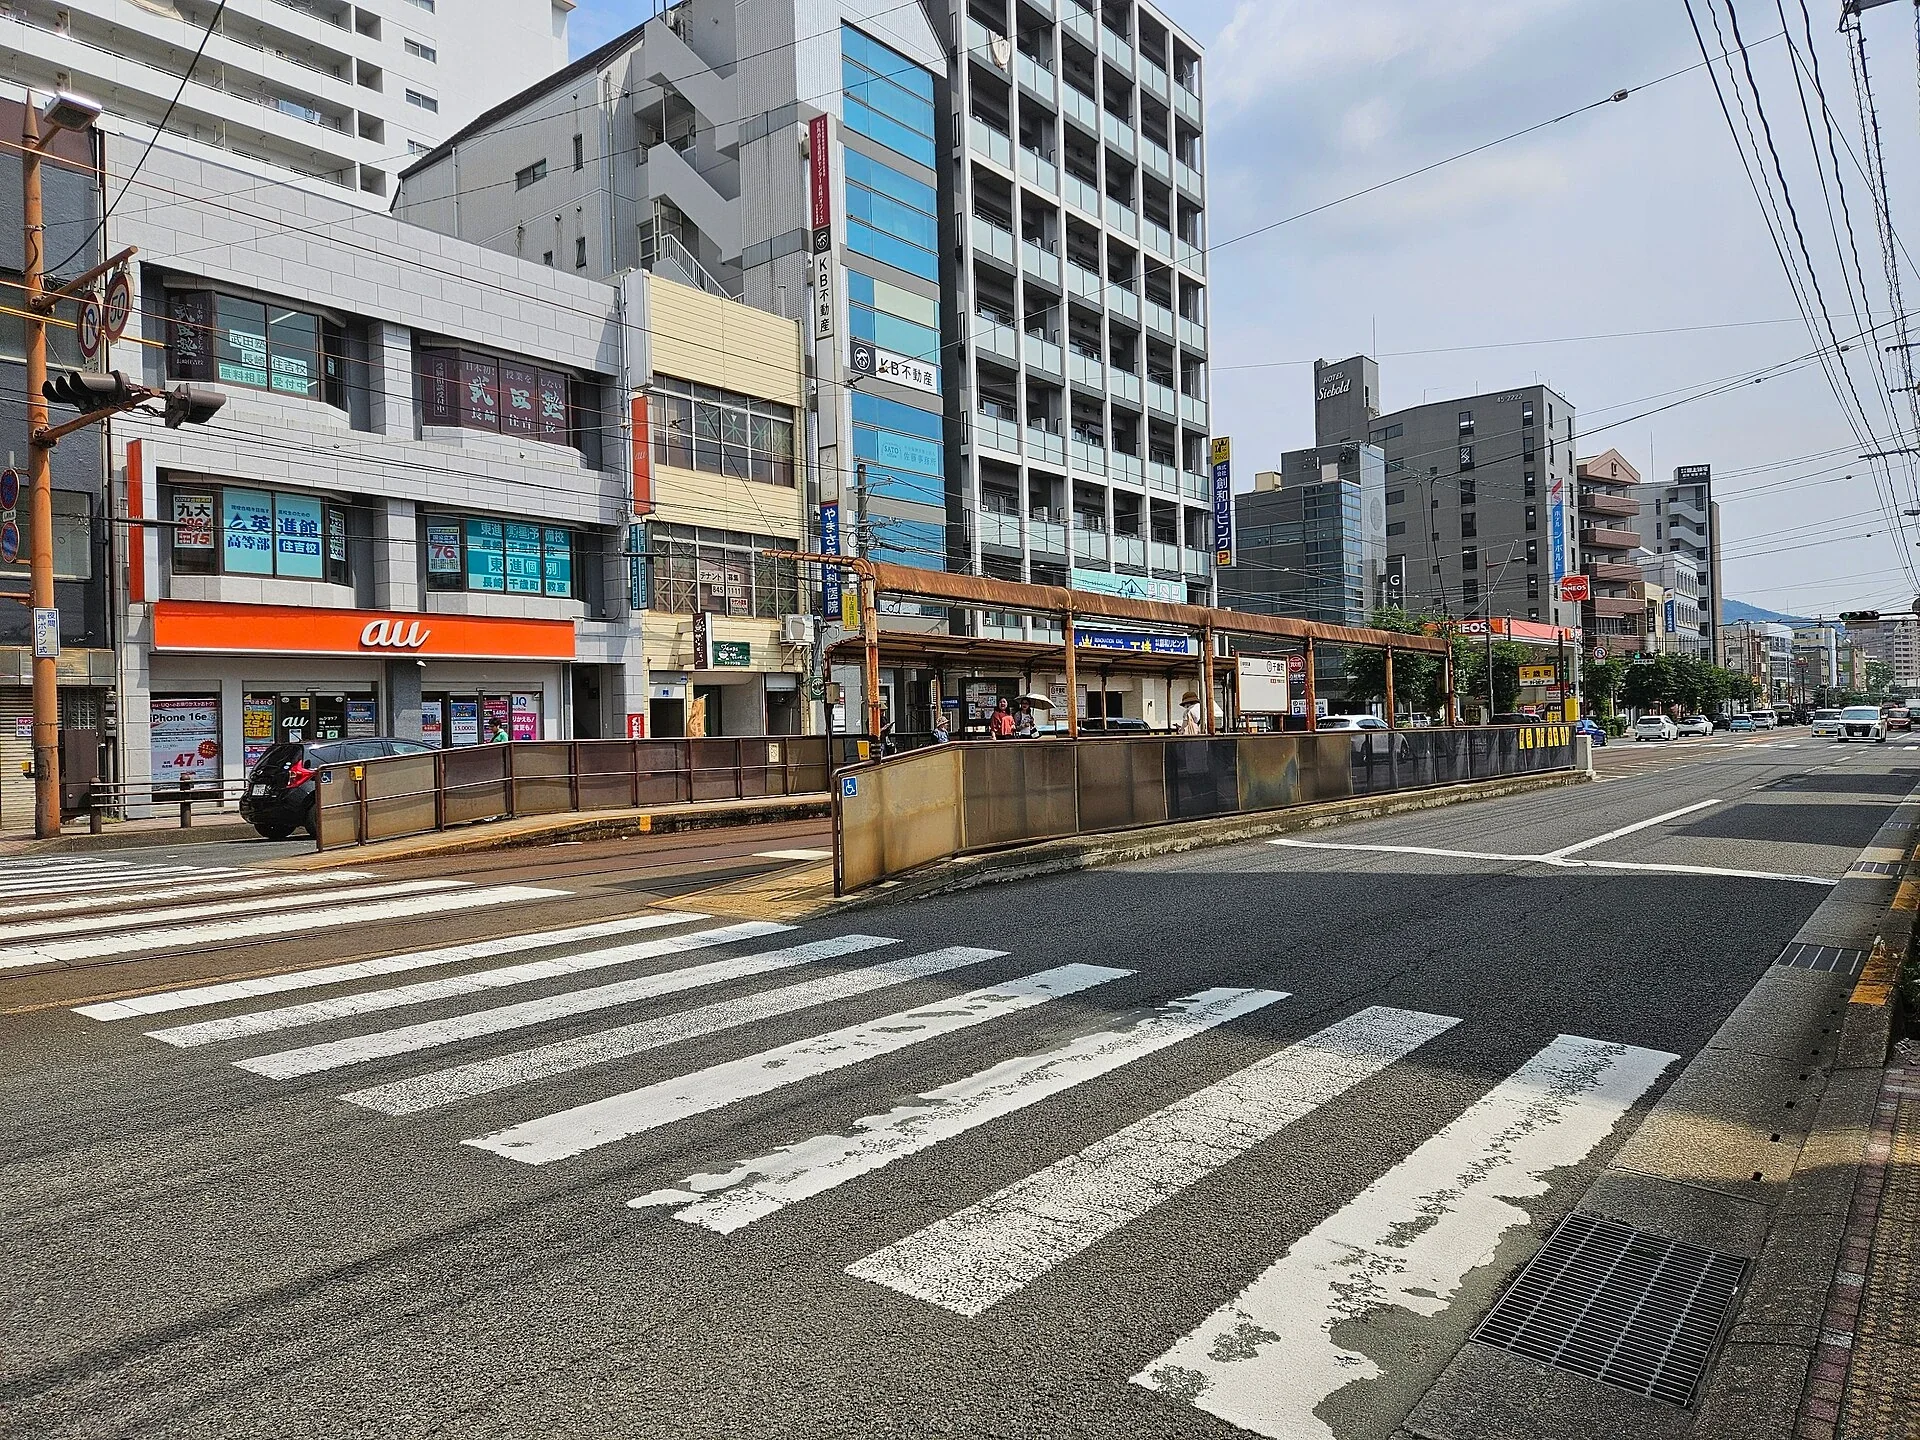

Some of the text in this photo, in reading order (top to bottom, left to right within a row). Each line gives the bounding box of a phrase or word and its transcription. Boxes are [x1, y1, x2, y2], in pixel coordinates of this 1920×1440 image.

[819, 257, 830, 333] KB不動産
[111, 291, 125, 324] 50
[220, 366, 308, 391] 無料相談受付中
[1323, 371, 1344, 384] HOTEL
[1317, 379, 1351, 400] Siebold
[884, 445, 899, 454] SATO
[177, 503, 211, 517] 九大
[1216, 477, 1230, 550] 創和リビング
[250, 514, 318, 538] 英進館
[192, 533, 210, 545] 15
[227, 535, 270, 551] 高等部
[282, 540, 317, 554] 住吉校
[432, 547, 455, 559] 76
[1555, 532, 1563, 569] シーボルト
[1218, 551, 1229, 563] P
[490, 555, 557, 577] 東進個別
[700, 572, 739, 582] テナント募集
[482, 577, 567, 593] 長崎千歳町教室
[712, 586, 724, 594] 845
[1561, 584, 1587, 592] NEOS
[360, 619, 432, 648] au
[1522, 669, 1552, 678] 千歳町
[150, 713, 207, 723] iPhone 16e
[281, 716, 309, 728] au
[173, 753, 196, 768] 47
